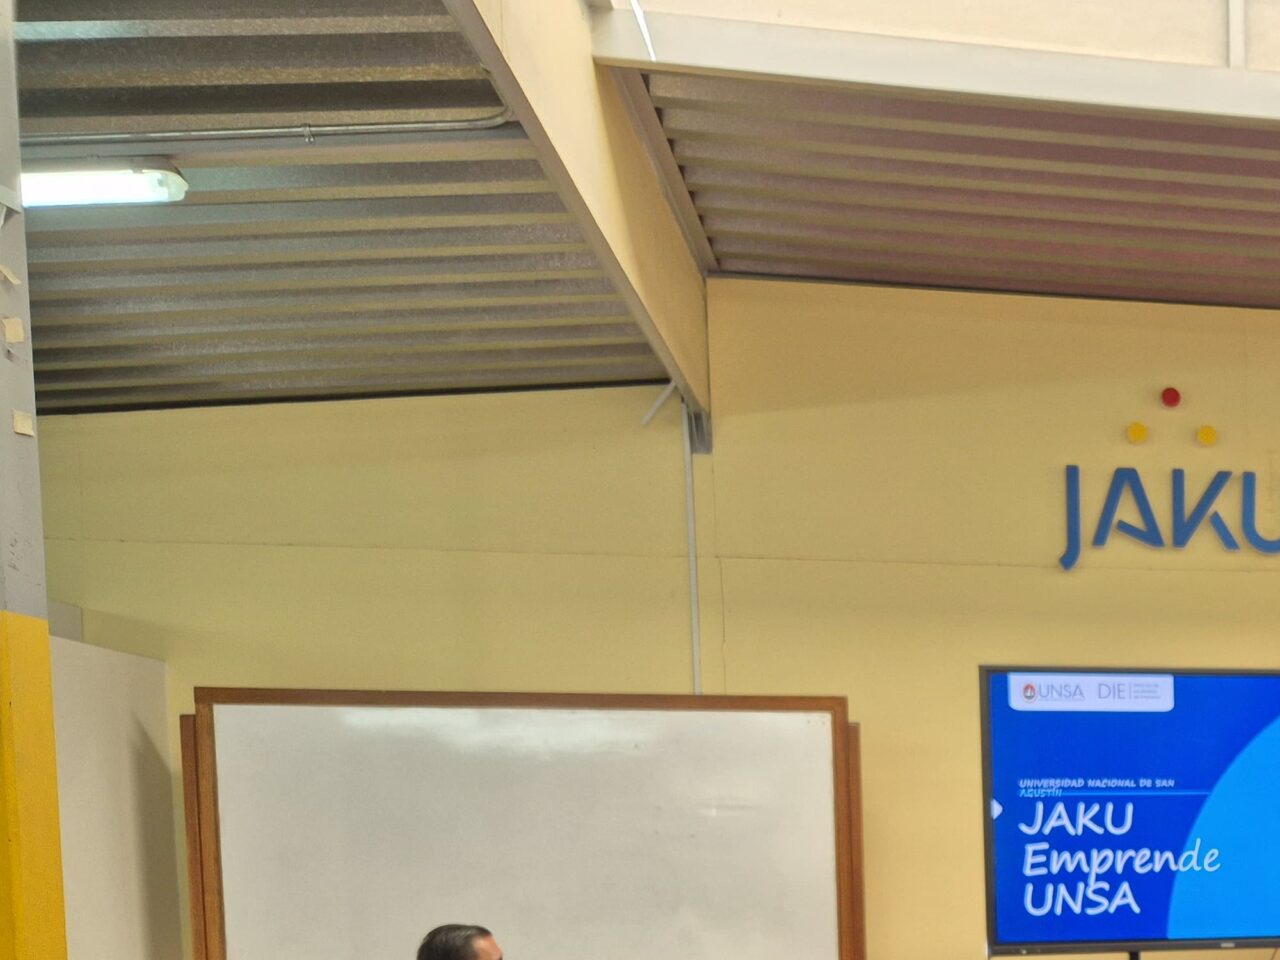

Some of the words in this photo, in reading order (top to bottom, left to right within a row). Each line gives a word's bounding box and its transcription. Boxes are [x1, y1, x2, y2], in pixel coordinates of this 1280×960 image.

[1037, 684, 1085, 699] UNSA
[1098, 683, 1126, 700] DIE
[1019, 778, 1085, 788] UNIVERSIDAD
[1087, 778, 1136, 788] NACIONAL
[1139, 778, 1152, 788] DE
[1155, 778, 1175, 788] SAN
[1018, 801, 1134, 836] JAKU
[1022, 838, 1221, 888] Emprende
[1023, 881, 1141, 917] UNSA
